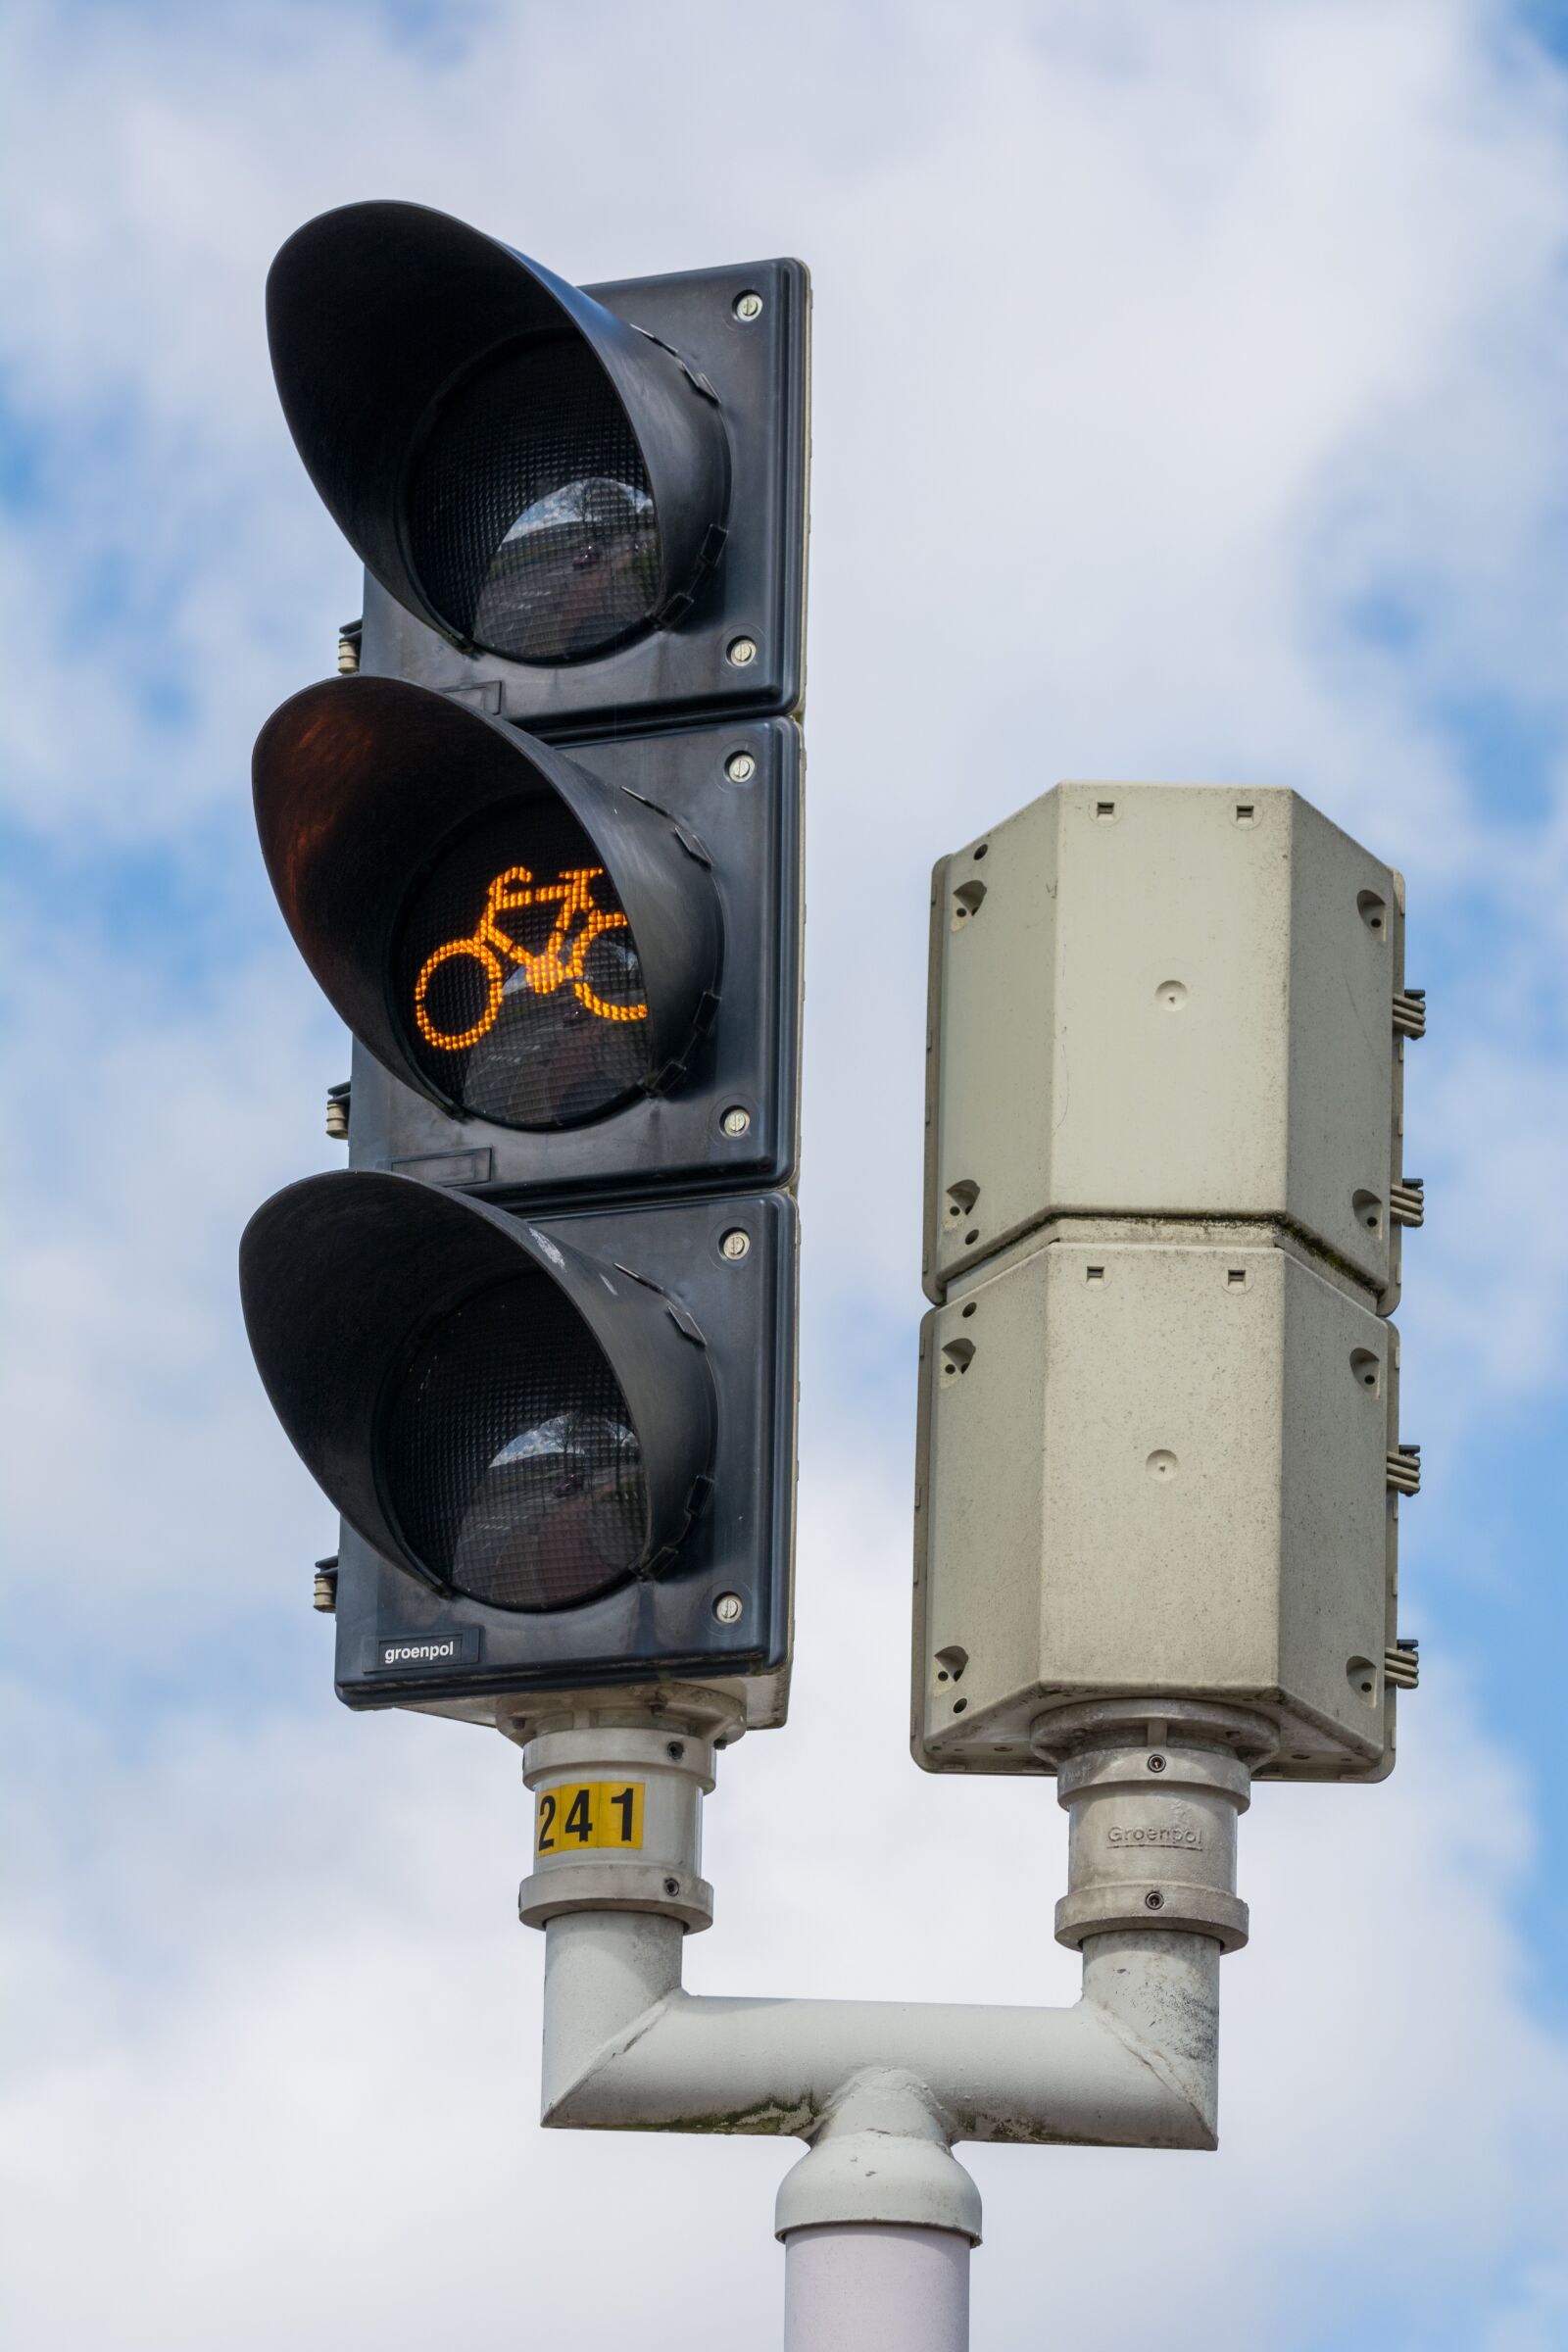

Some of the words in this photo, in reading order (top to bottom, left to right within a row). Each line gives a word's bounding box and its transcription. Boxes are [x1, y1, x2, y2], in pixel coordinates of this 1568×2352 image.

[384, 1641, 454, 1664] groenpol
[538, 1787, 634, 1852] 241
[1108, 1826, 1203, 1844] Groenpol
